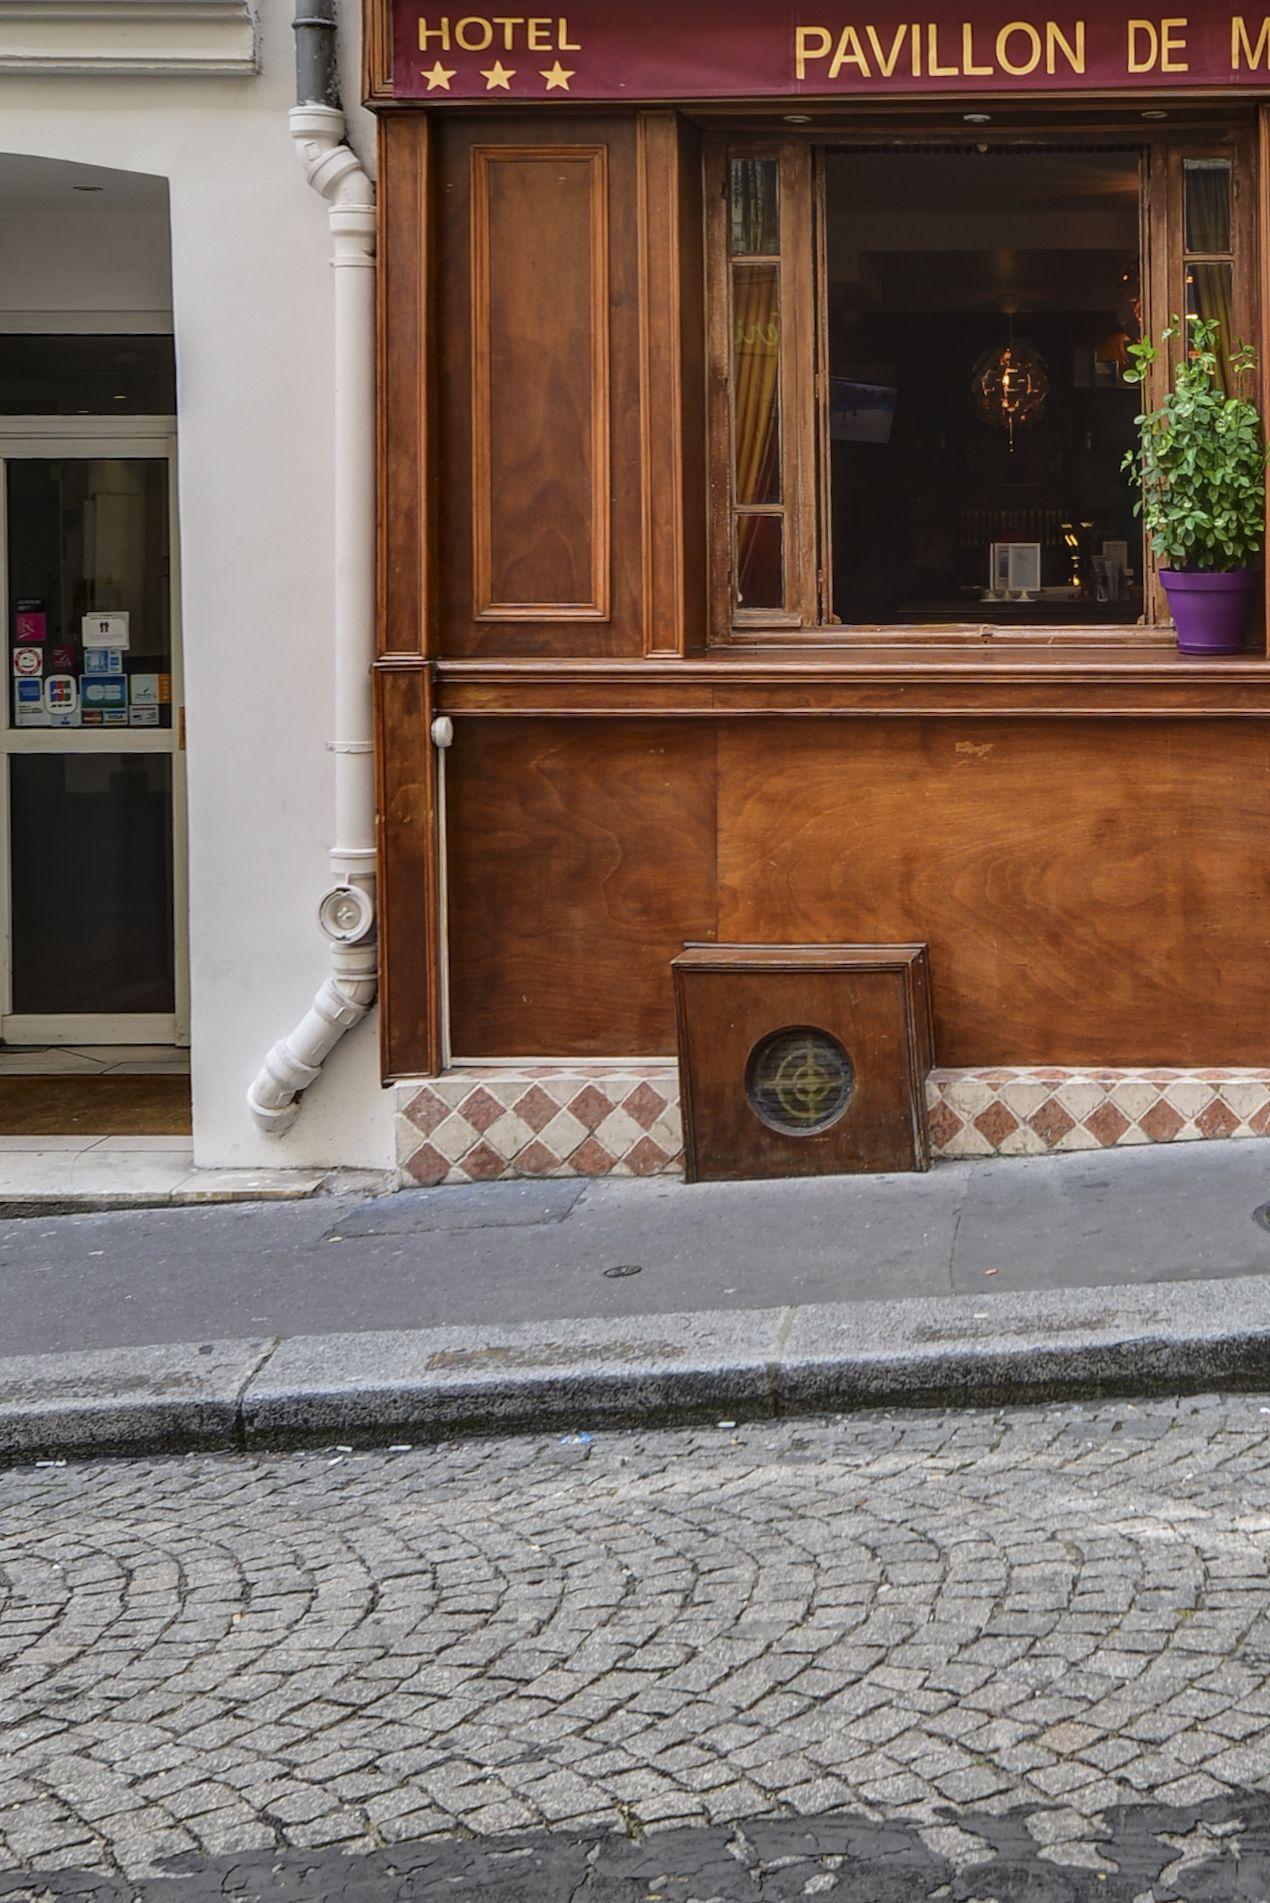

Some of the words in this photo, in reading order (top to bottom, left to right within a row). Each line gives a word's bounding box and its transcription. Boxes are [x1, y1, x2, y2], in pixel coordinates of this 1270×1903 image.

[418, 15, 582, 52] HOTEL
[794, 20, 1086, 80] PAVILLON
[1126, 17, 1190, 73] DE
